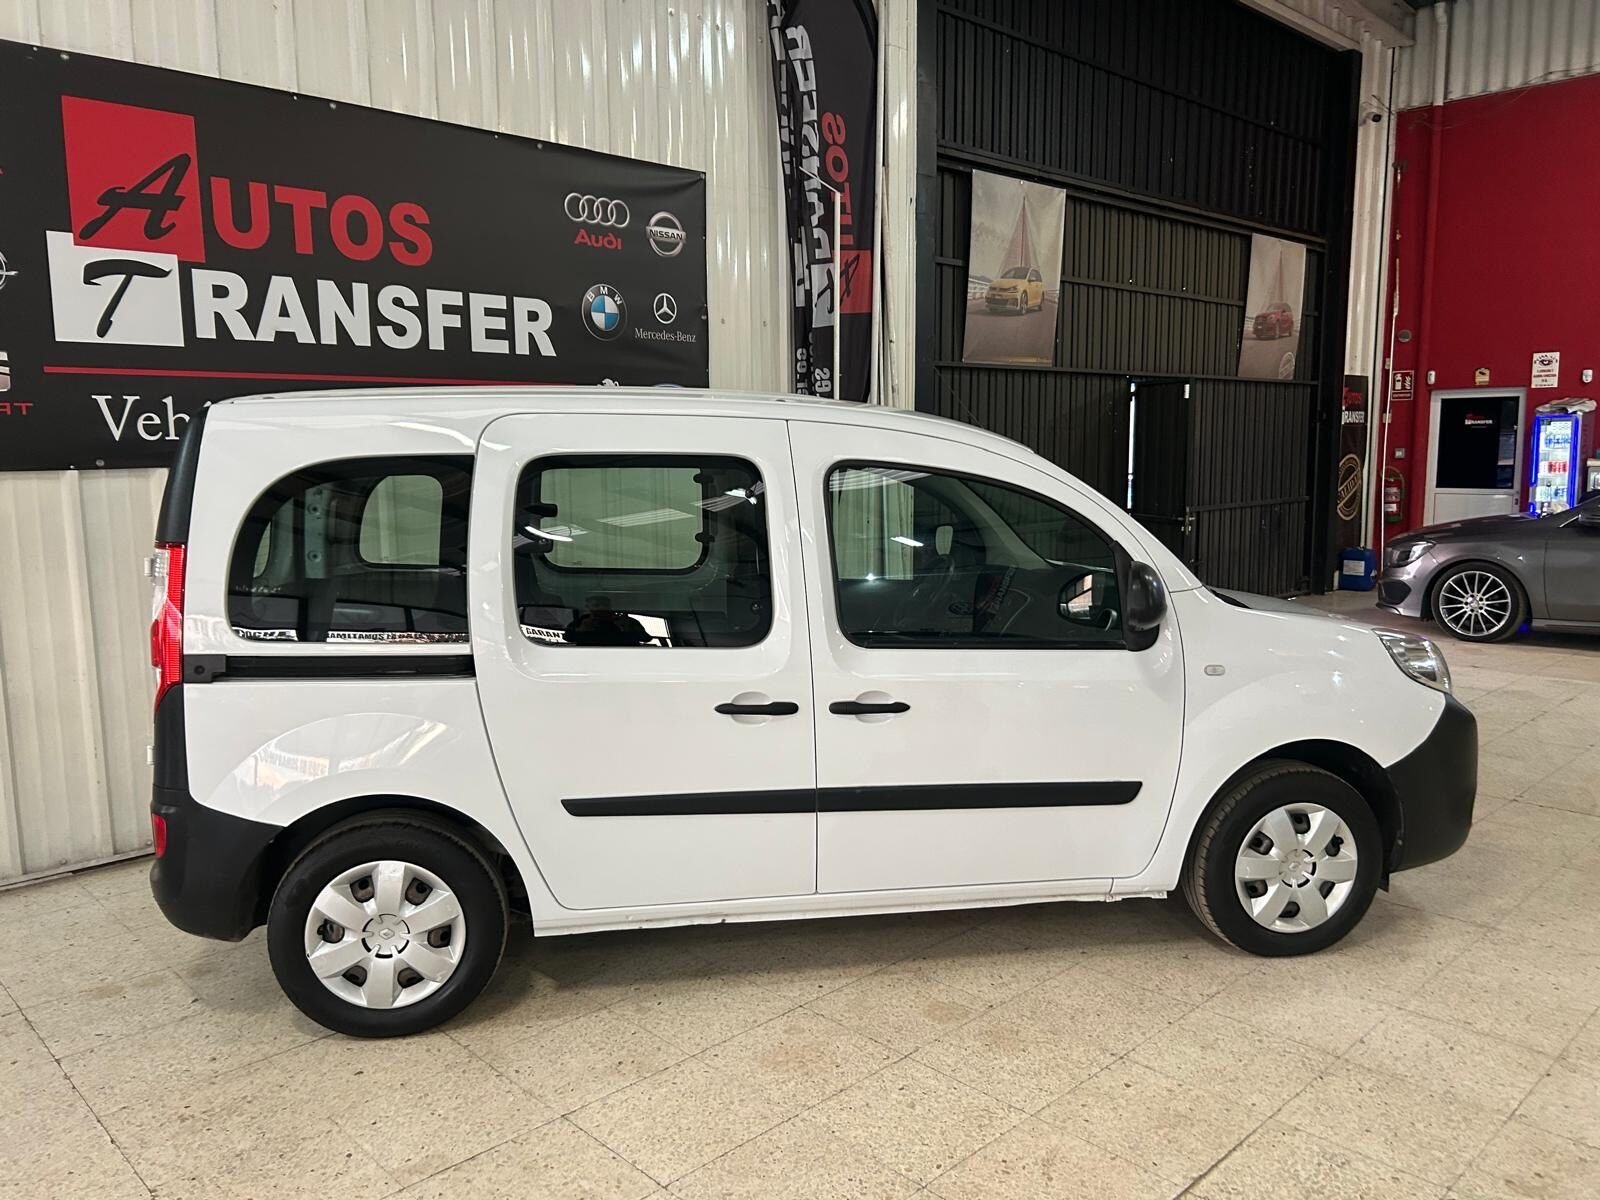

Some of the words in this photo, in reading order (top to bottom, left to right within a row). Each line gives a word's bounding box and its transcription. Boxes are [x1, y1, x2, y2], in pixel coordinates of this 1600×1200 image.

[79, 153, 433, 267] AUTOS
[574, 228, 623, 250] Audi
[650, 228, 684, 241] NISSAN
[586, 286, 623, 305] BMW
[83, 257, 557, 358] TRANSFER
[634, 327, 697, 343] Mercedes-Benz
